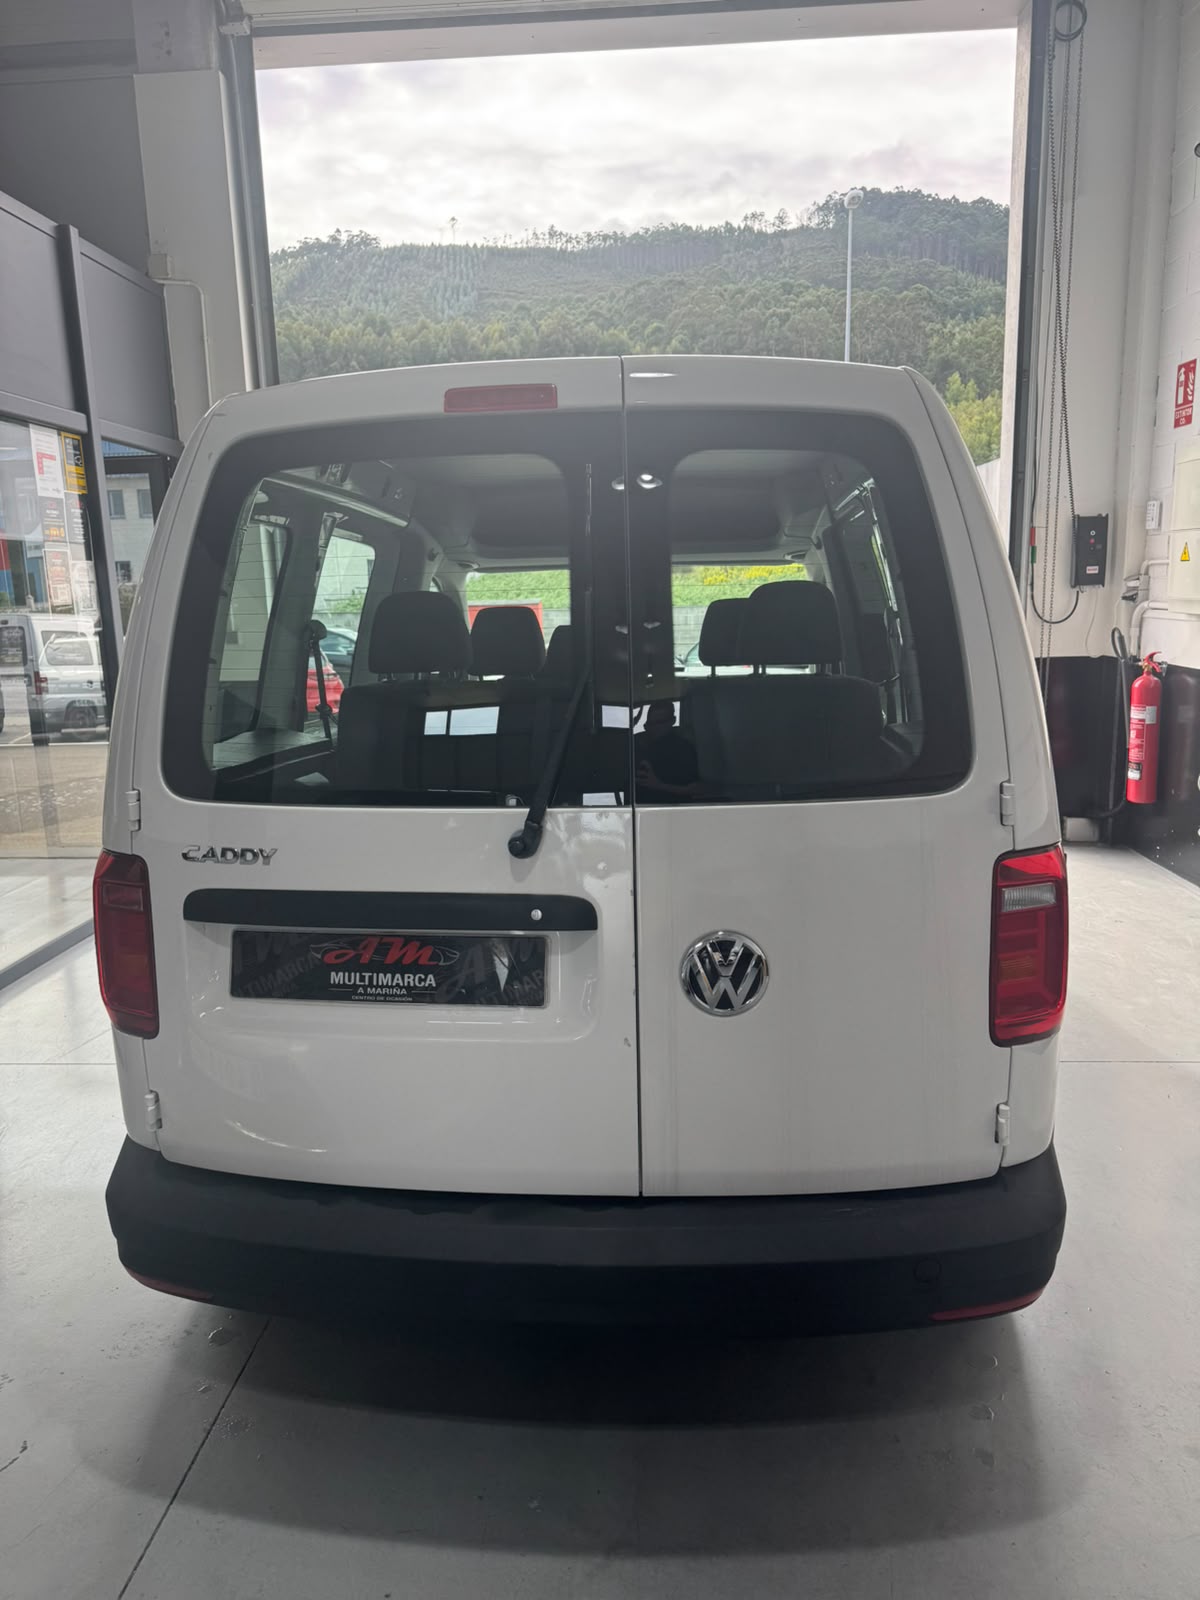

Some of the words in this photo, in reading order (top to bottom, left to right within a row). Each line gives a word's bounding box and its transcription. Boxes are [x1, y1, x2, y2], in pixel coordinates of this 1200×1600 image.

[181, 845, 279, 866] CADDY
[330, 971, 436, 987] MULTIMARCA
[367, 987, 407, 995] MARIÑA
